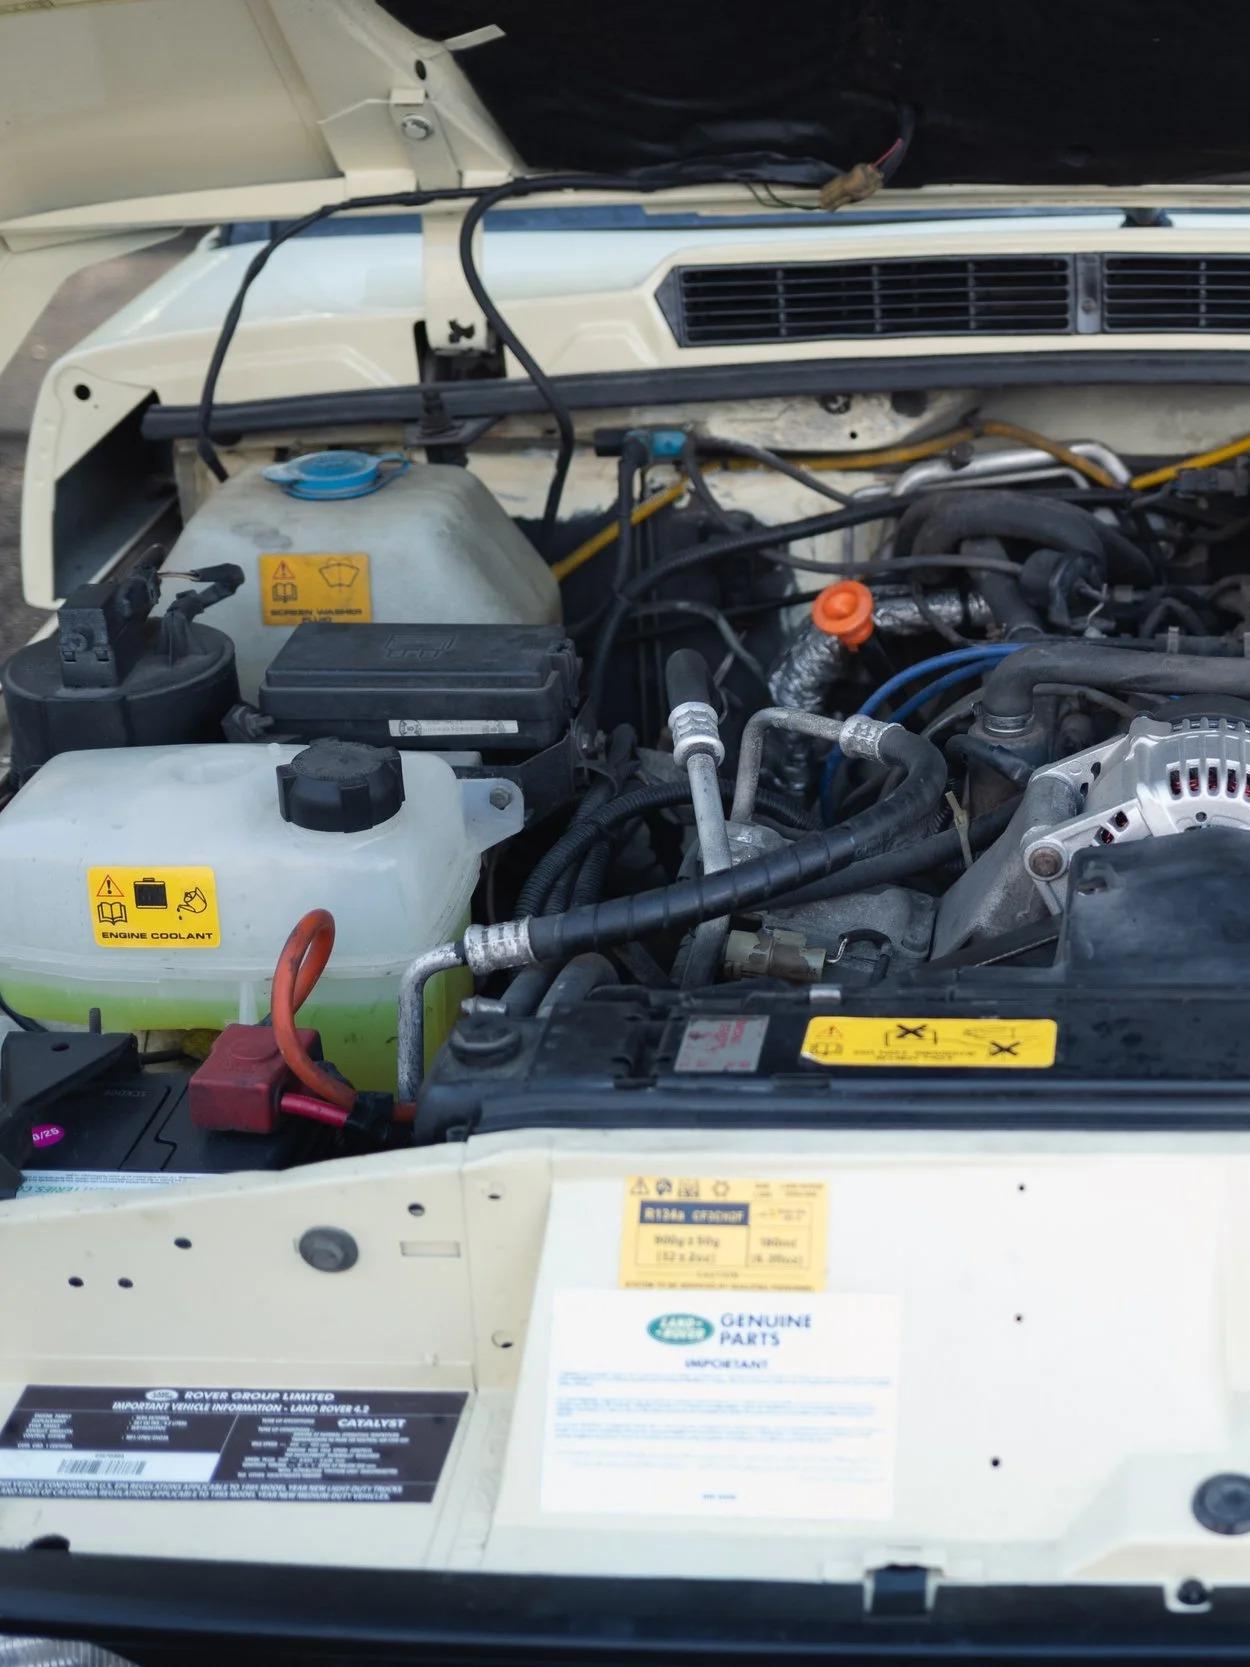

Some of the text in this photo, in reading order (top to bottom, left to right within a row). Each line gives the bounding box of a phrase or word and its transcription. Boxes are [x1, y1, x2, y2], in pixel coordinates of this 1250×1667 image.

[271, 608, 362, 616] SCREEN WASHER
[102, 932, 213, 940] ENGINE COOLANT
[720, 1313, 812, 1328] GENUINE
[720, 1332, 780, 1346] PARTS
[684, 1359, 769, 1369] IMPORTANT
[184, 1391, 335, 1402] ROVER GROUP LIMITED
[112, 1401, 170, 1411] IMPORTANT
[172, 1402, 210, 1411] VEHICLE
[211, 1403, 282, 1412] INFORMATION
[290, 1404, 318, 1413] LAND
[320, 1405, 353, 1413] ROVER
[337, 1418, 406, 1428] CATALYST
